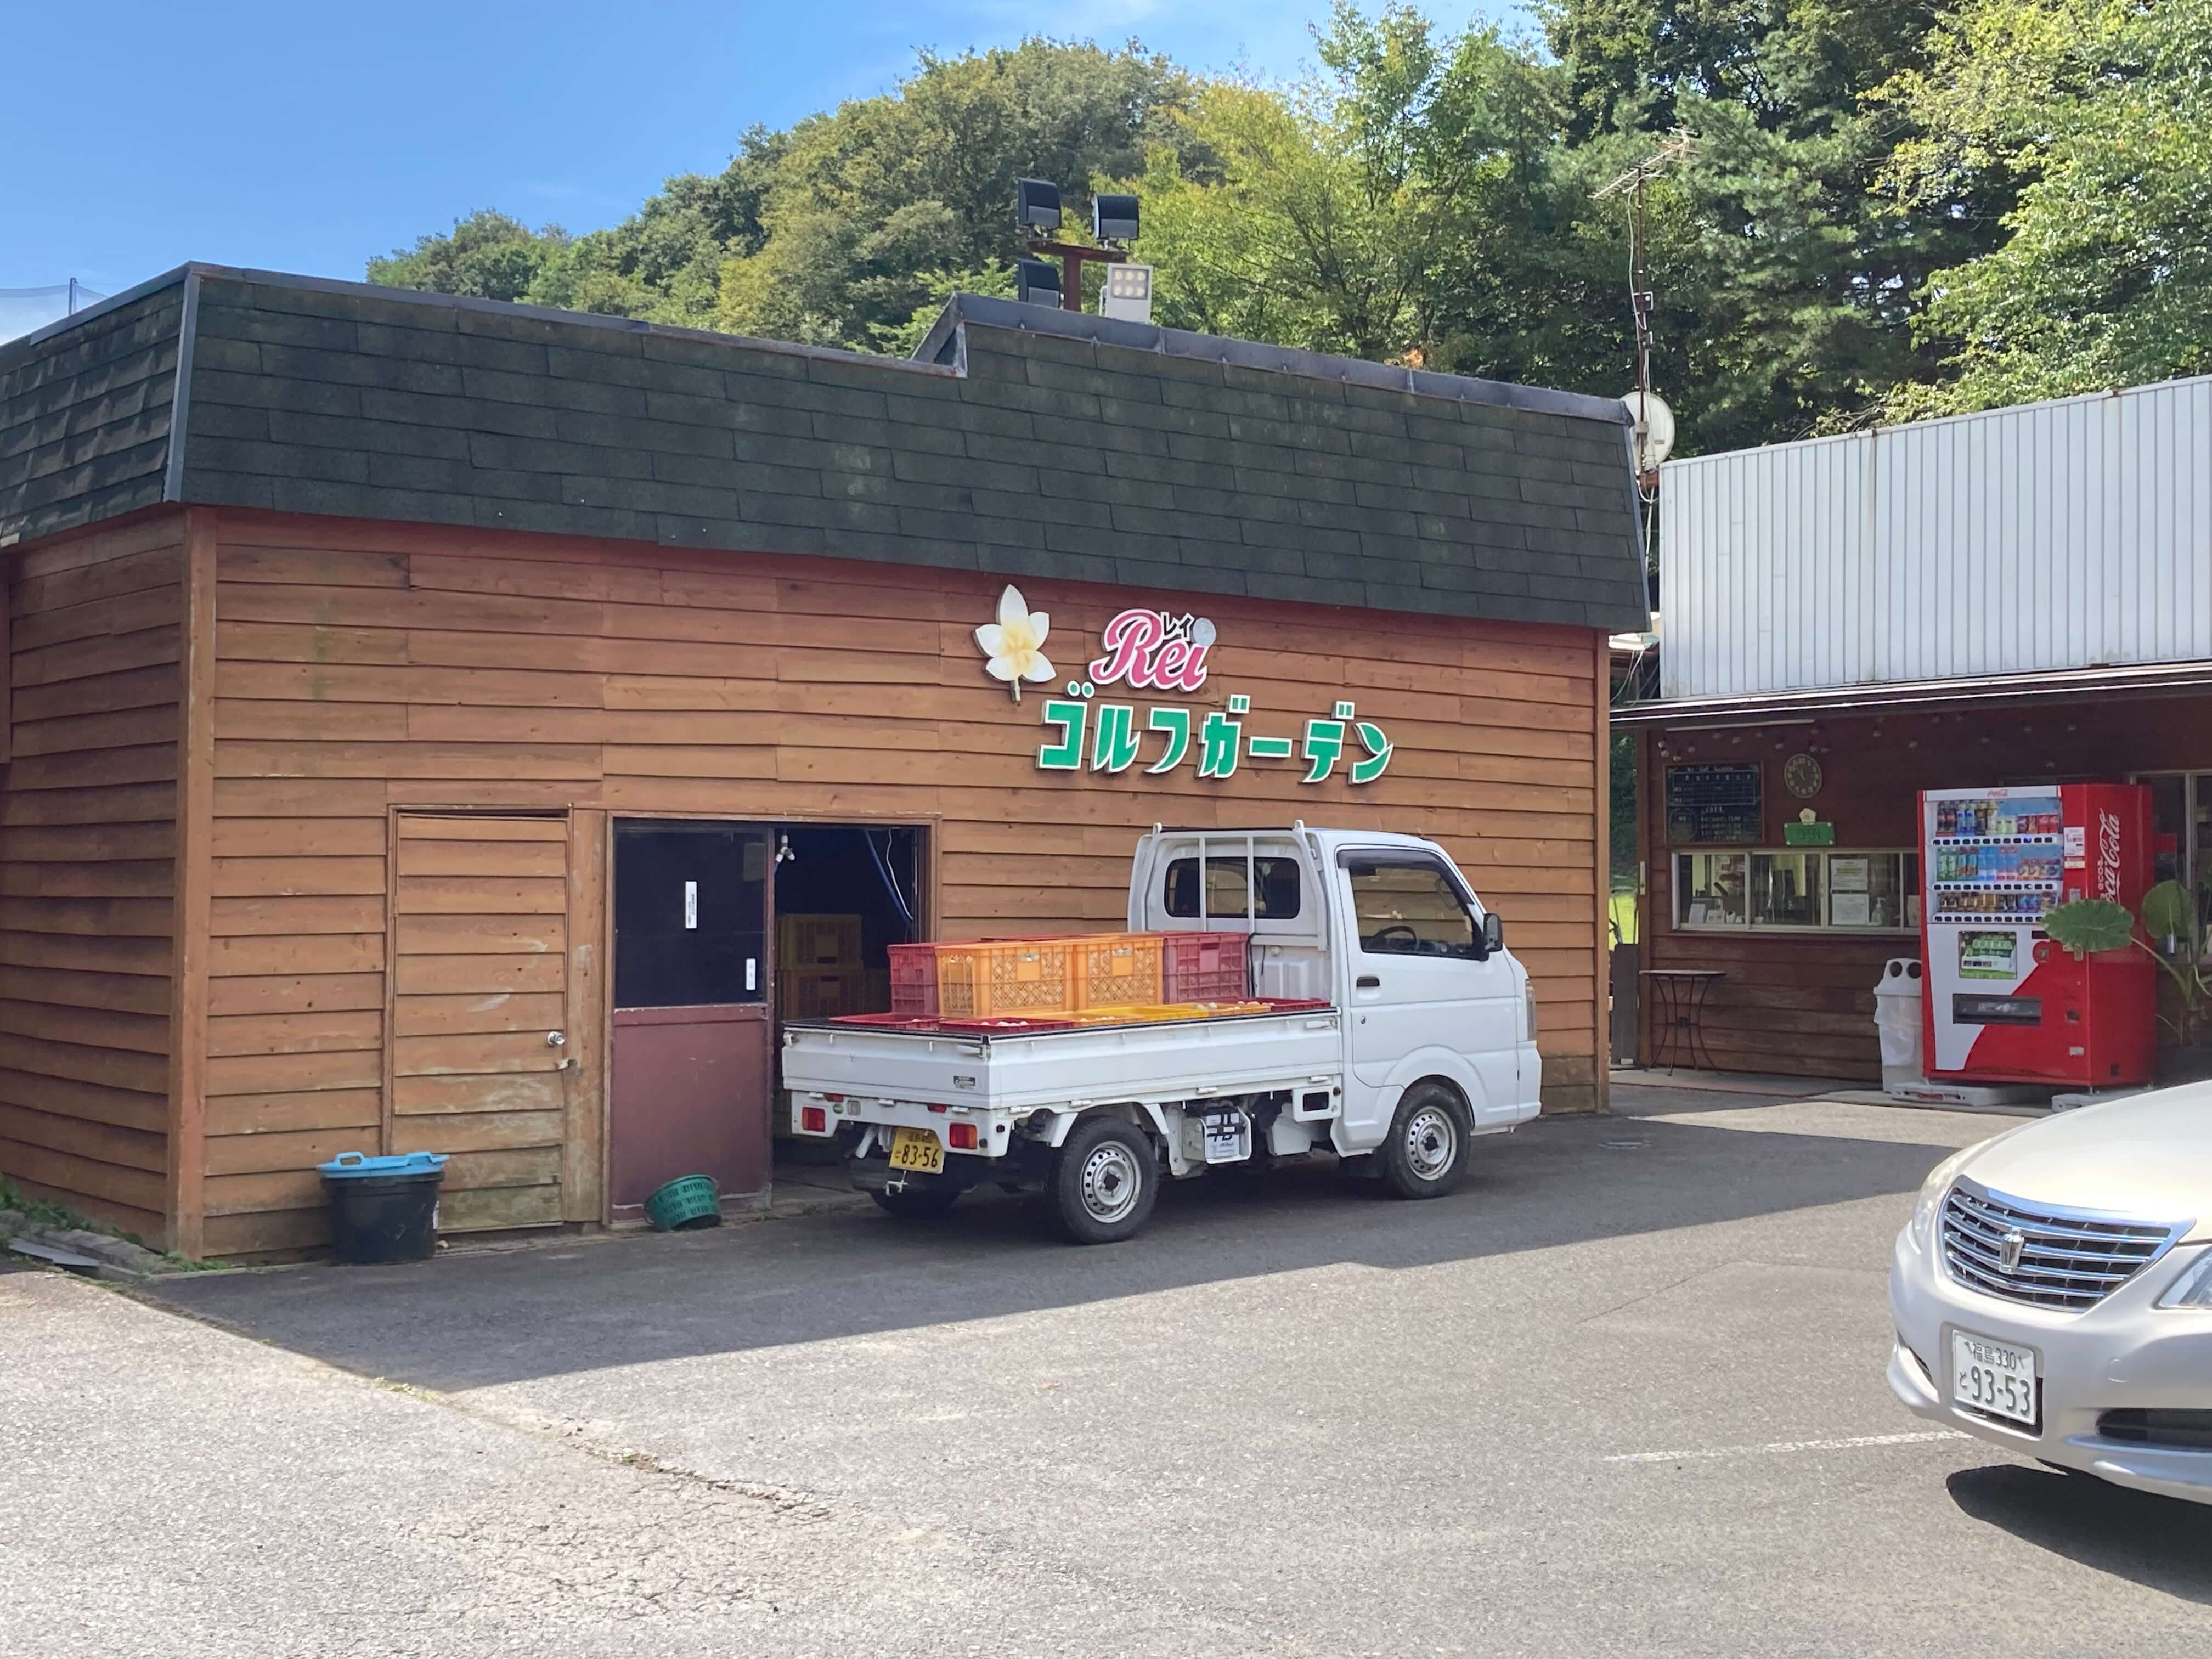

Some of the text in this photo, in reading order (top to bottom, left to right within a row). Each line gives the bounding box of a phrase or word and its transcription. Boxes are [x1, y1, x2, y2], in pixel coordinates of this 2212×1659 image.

[1162, 612, 1193, 640] レイ
[1090, 608, 1211, 692] Rei
[1036, 680, 1394, 785] ゴルフガーデン
[902, 1145, 939, 1168] 83-56
[1972, 1342, 2017, 1370] 福島330
[1960, 1365, 2030, 1416] と 93-53
